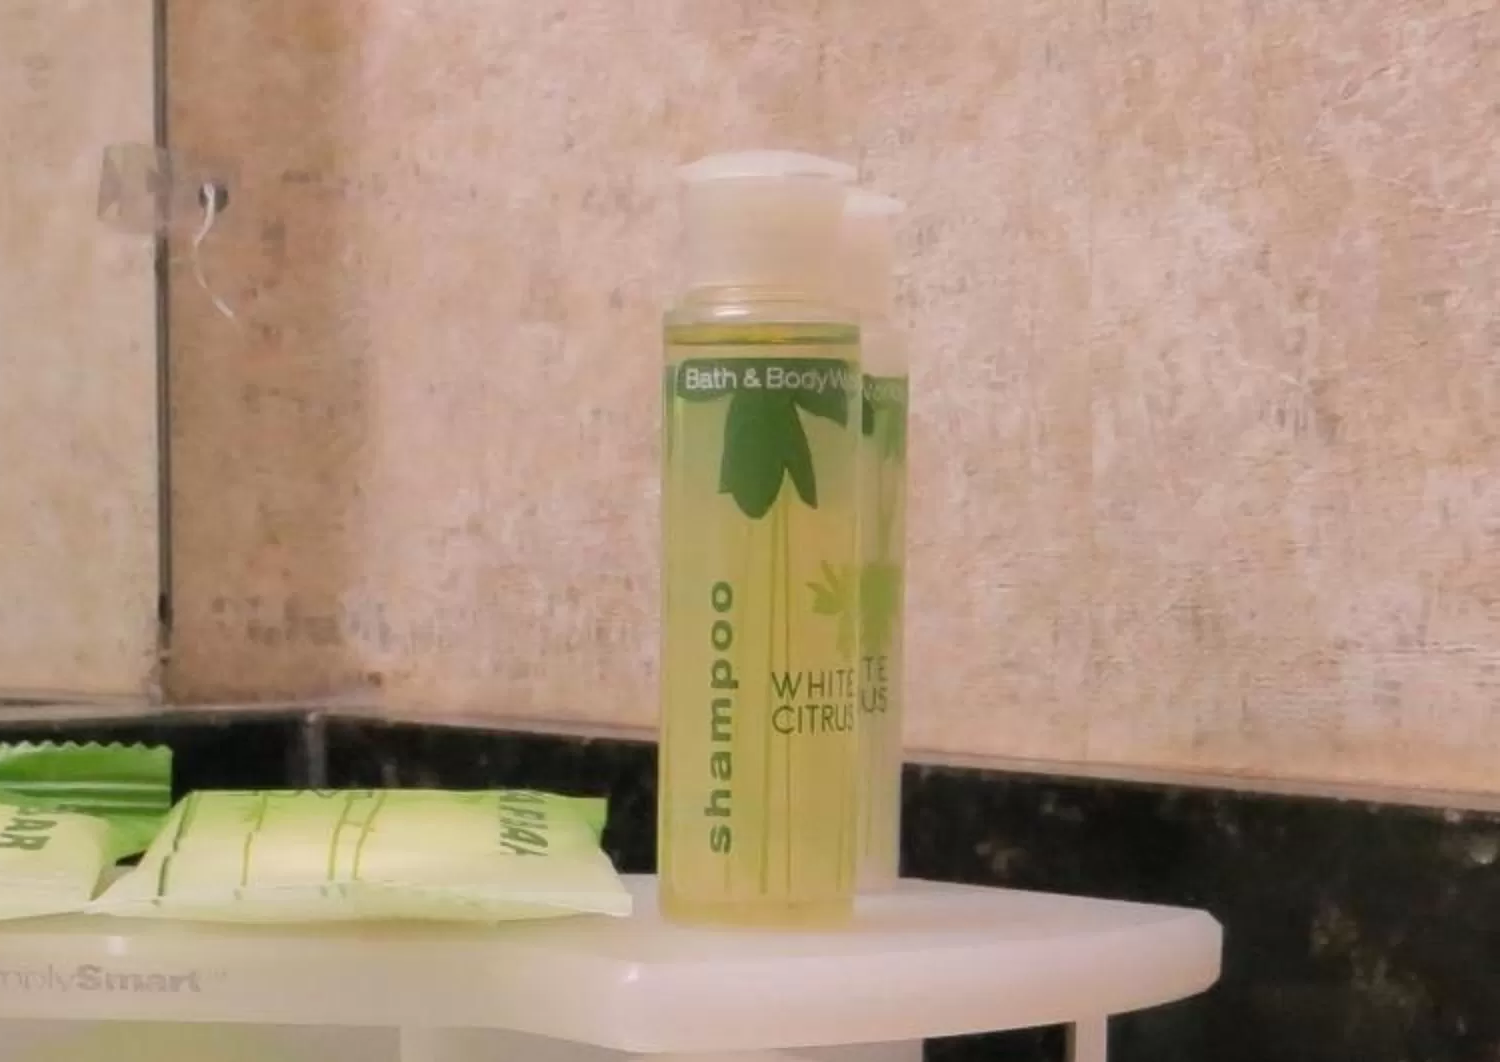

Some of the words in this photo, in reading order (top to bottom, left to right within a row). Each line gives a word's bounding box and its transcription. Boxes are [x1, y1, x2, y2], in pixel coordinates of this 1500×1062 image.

[685, 367, 738, 389] Bath
[743, 367, 761, 388] &
[771, 668, 855, 700] WHITE
[704, 580, 739, 855] shampoo
[771, 703, 854, 735] CITRUS
